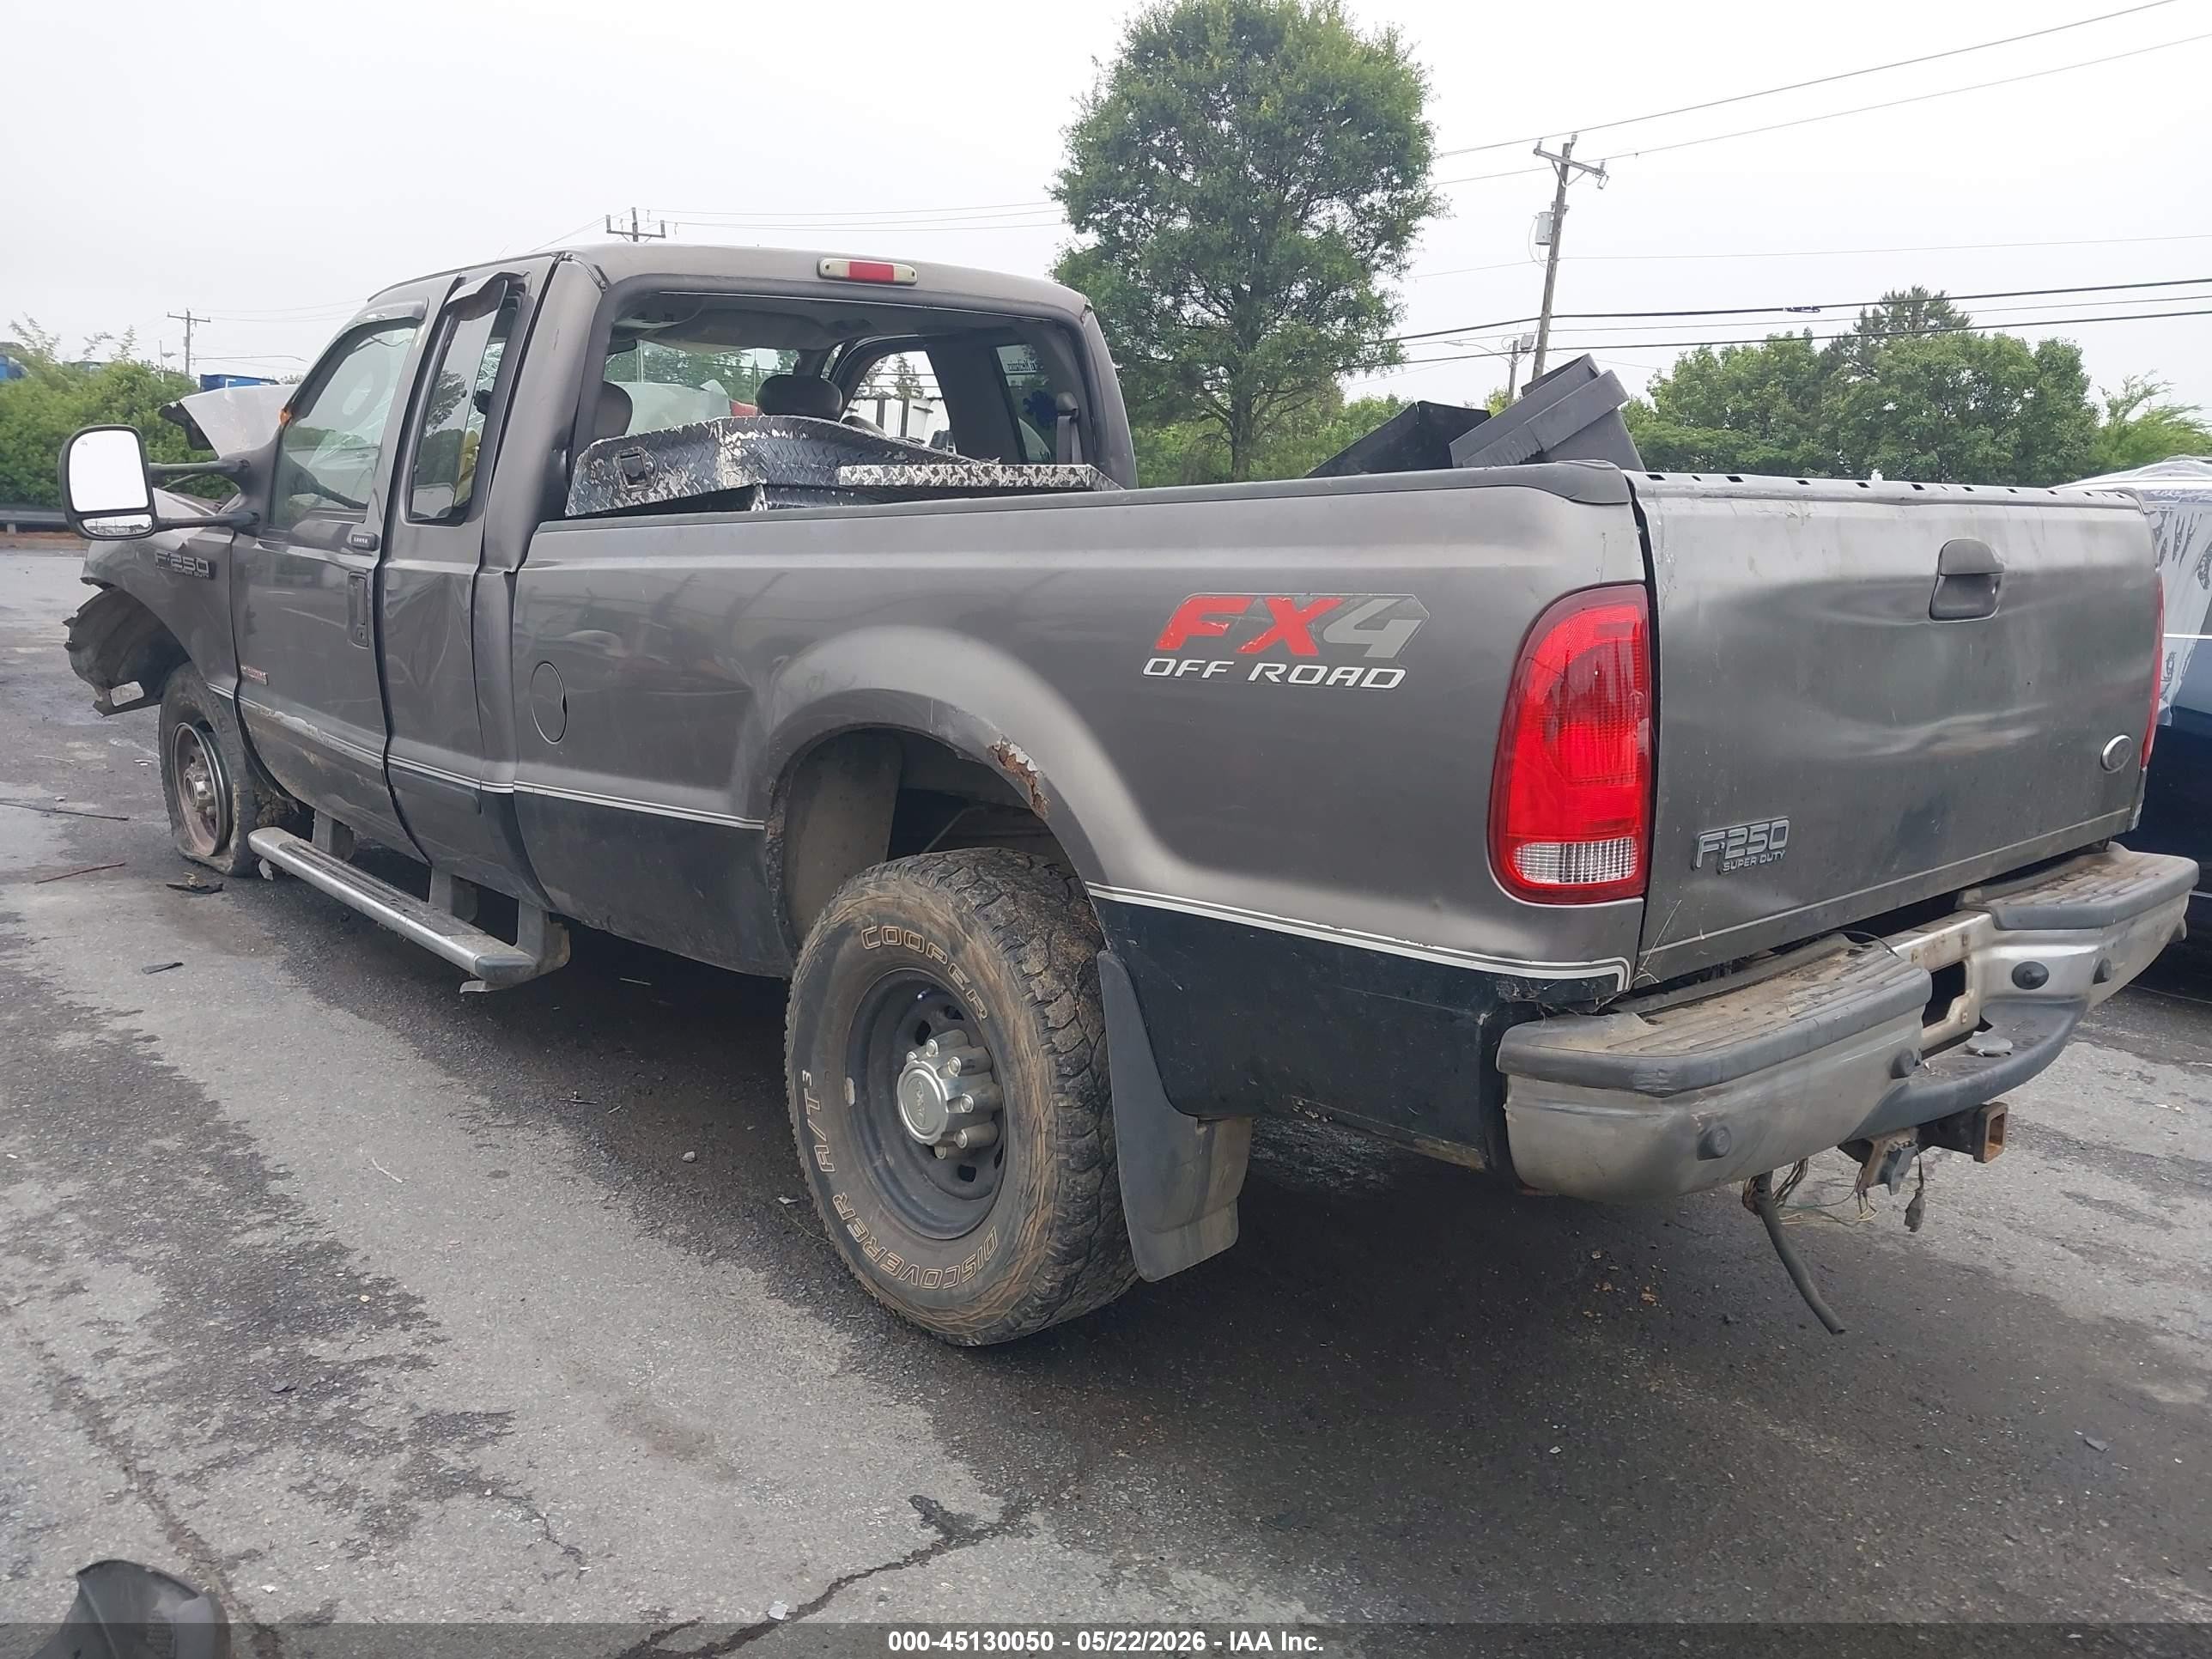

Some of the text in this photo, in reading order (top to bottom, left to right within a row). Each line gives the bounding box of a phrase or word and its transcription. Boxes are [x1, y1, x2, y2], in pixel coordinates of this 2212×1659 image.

[1155, 596, 1423, 659] FX4
[1142, 658, 1407, 689] OFF ROAD
[1723, 849, 1787, 872] SUPER DUTY
[861, 926, 988, 1020] COOPER
[832, 1191, 999, 1291] DISCOVERER
